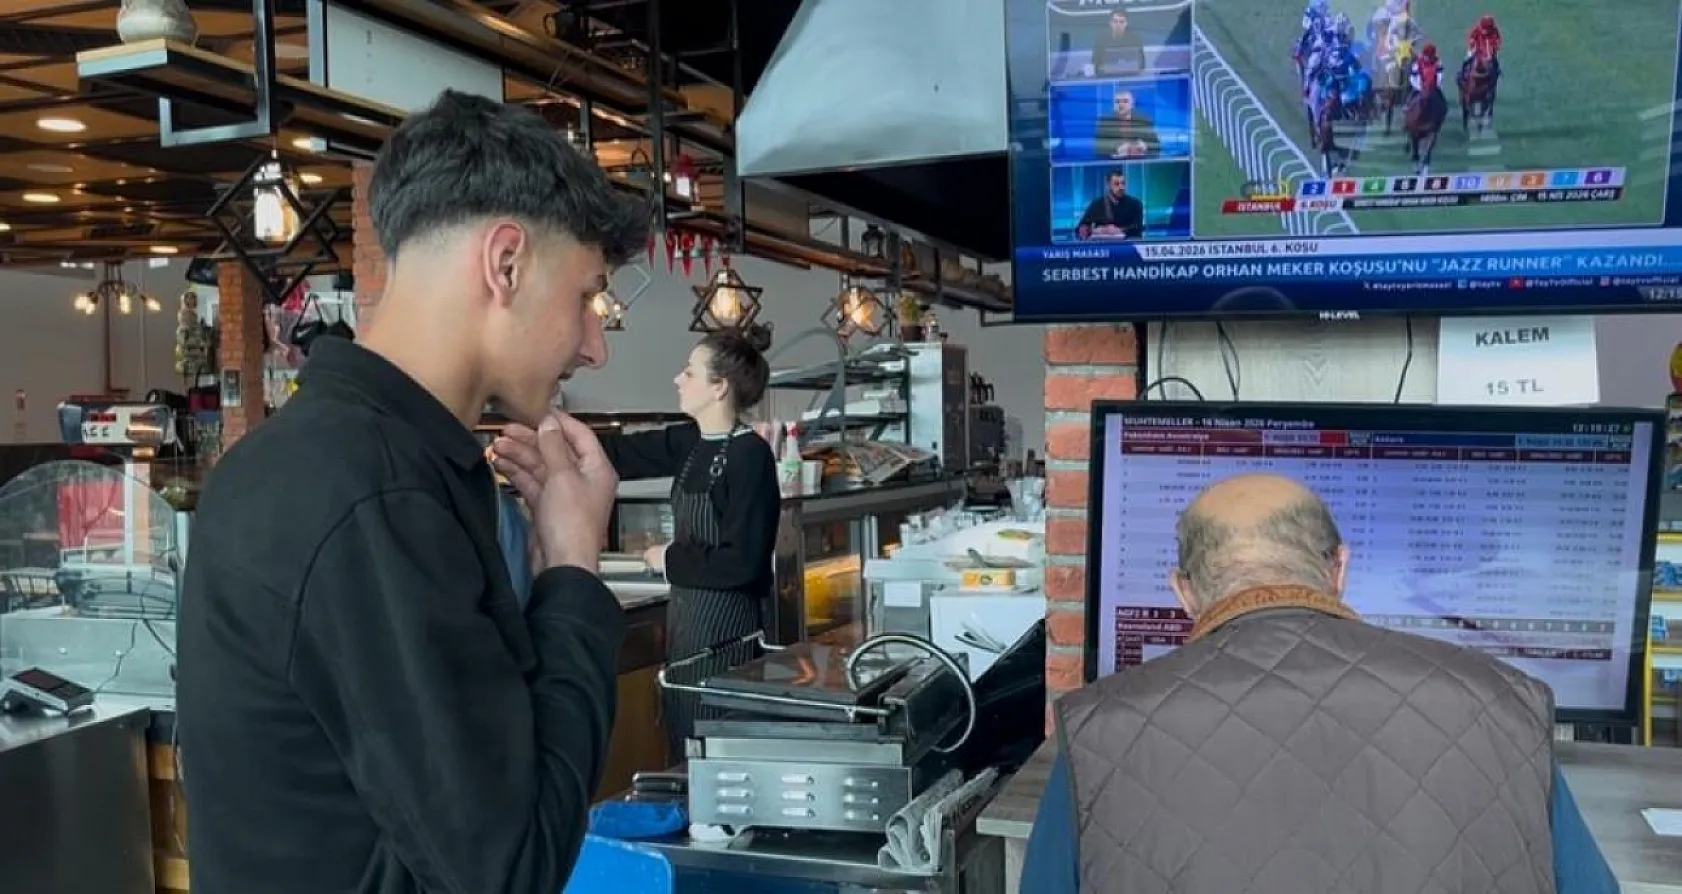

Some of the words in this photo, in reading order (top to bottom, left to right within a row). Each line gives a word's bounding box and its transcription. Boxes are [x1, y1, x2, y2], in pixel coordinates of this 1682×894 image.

[1145, 244, 1206, 256] 15.04.2026
[1042, 266, 1109, 281] SERBEST
[1113, 263, 1199, 280] HANDİKAP
[1203, 263, 1262, 278] ORHAN
[1267, 261, 1324, 276] MEKER
[1475, 326, 1550, 347] KALEM
[1486, 380, 1509, 395] 15
[1516, 378, 1544, 393] TL
